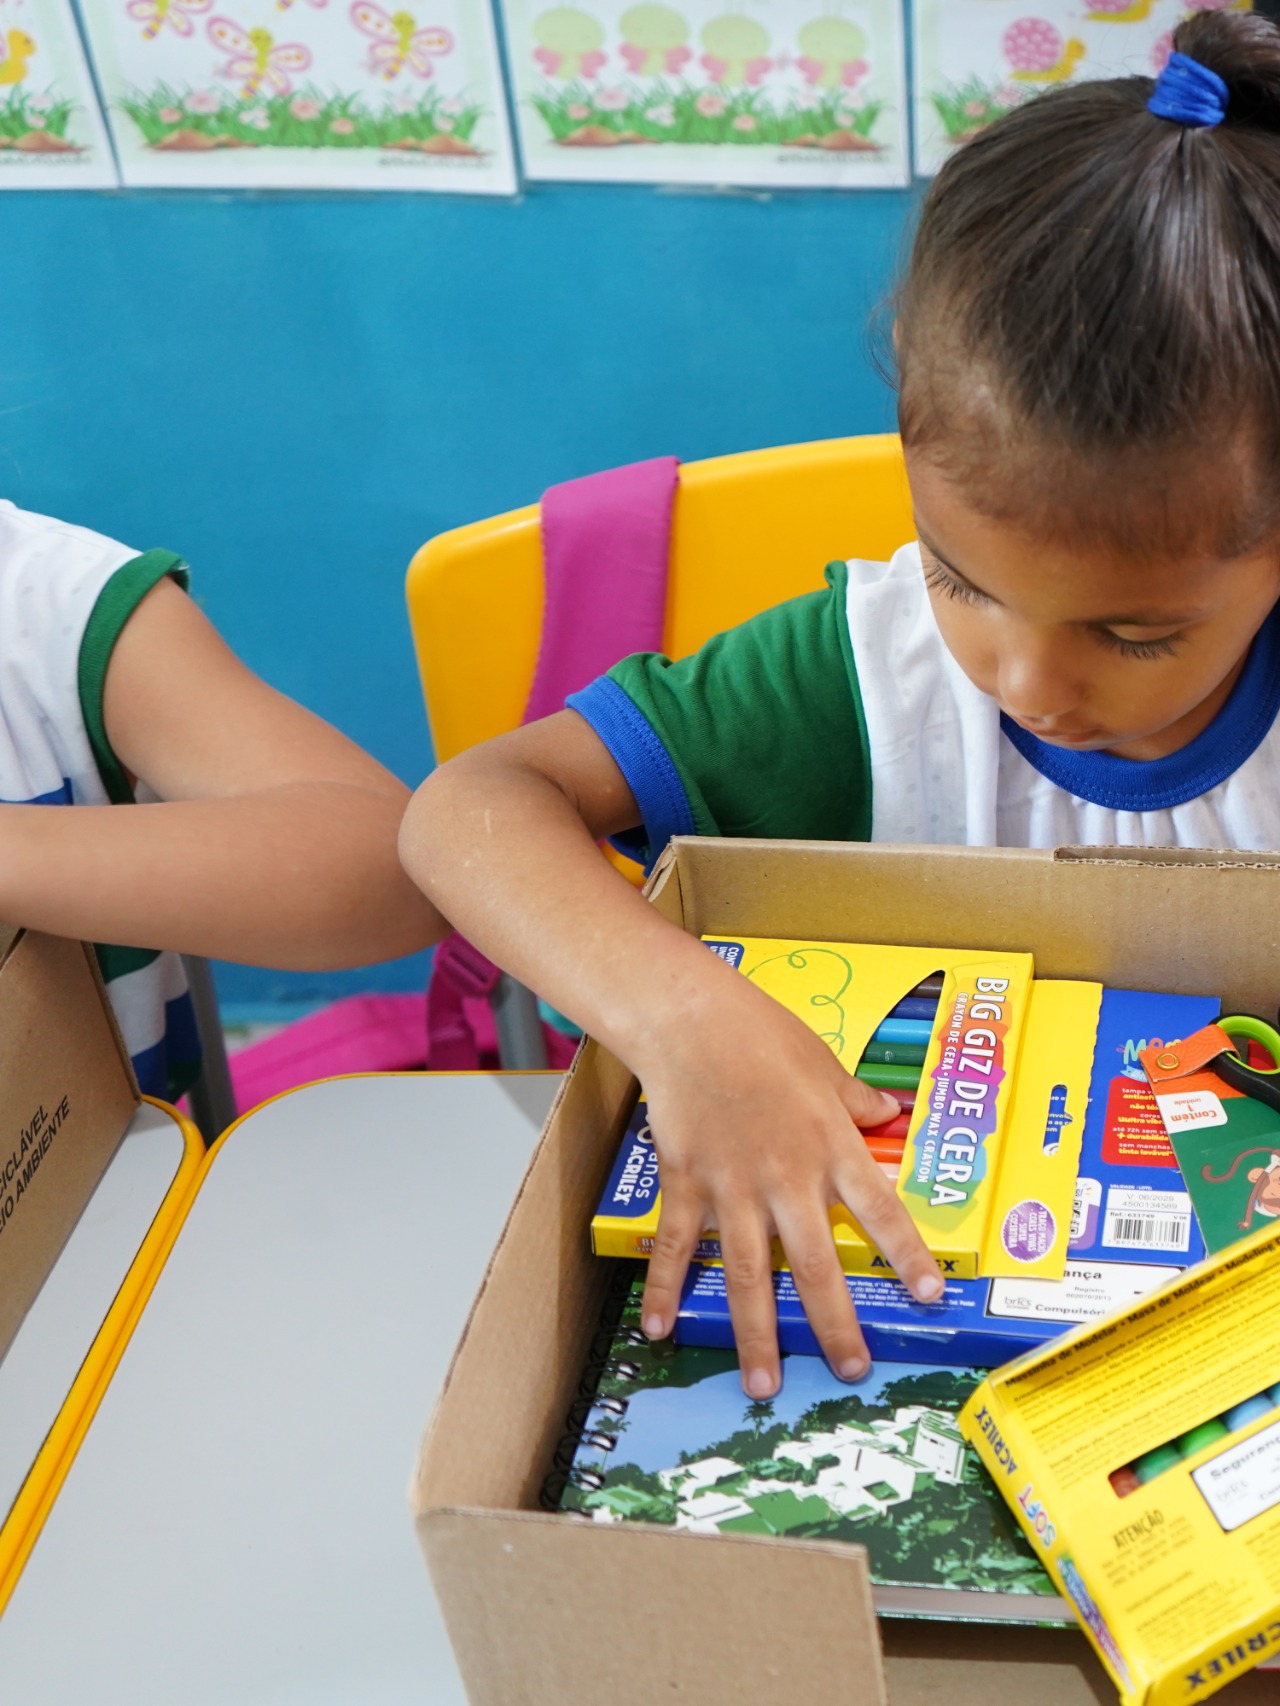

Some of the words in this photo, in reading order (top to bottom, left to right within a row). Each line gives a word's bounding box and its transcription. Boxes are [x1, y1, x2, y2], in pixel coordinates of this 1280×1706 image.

[951, 992, 968, 1029] CRAYON
[969, 976, 1009, 1021] BIG
[948, 1030, 960, 1043] DE
[957, 1028, 998, 1076] GIZ
[941, 1046, 956, 1071] CERA
[933, 1076, 950, 1110] JUMBO
[948, 1080, 988, 1119] DE
[926, 1112, 942, 1136] WAX
[1170, 1110, 1218, 1122] Contém
[0, 1105, 48, 1197] ICLÁVEL
[16, 1094, 70, 1203] AMBIENTE
[917, 1139, 934, 1184] CRAYON
[929, 1126, 978, 1207] CERA
[612, 1144, 648, 1206] ACRILEX
[636, 1152, 658, 1199] anos
[1018, 1222, 1027, 1241] SUPER
[1028, 1212, 1037, 1232] CORES
[1028, 1233, 1037, 1252] VIVAS
[1004, 1356, 1056, 1388] Massinha
[1056, 1347, 1073, 1361] de
[1073, 1323, 1118, 1352] Modelar
[1127, 1303, 1156, 1324] Masa
[1156, 1294, 1172, 1308] de
[1172, 1271, 1217, 1300] Moldear
[1224, 1240, 1275, 1273] Modeling
[1036, 1304, 1105, 1316] Compulsóri
[973, 1405, 1018, 1476] ACRILEX
[1016, 1484, 1056, 1548] SOFT
[1112, 1509, 1166, 1549] ATENÇÃO
